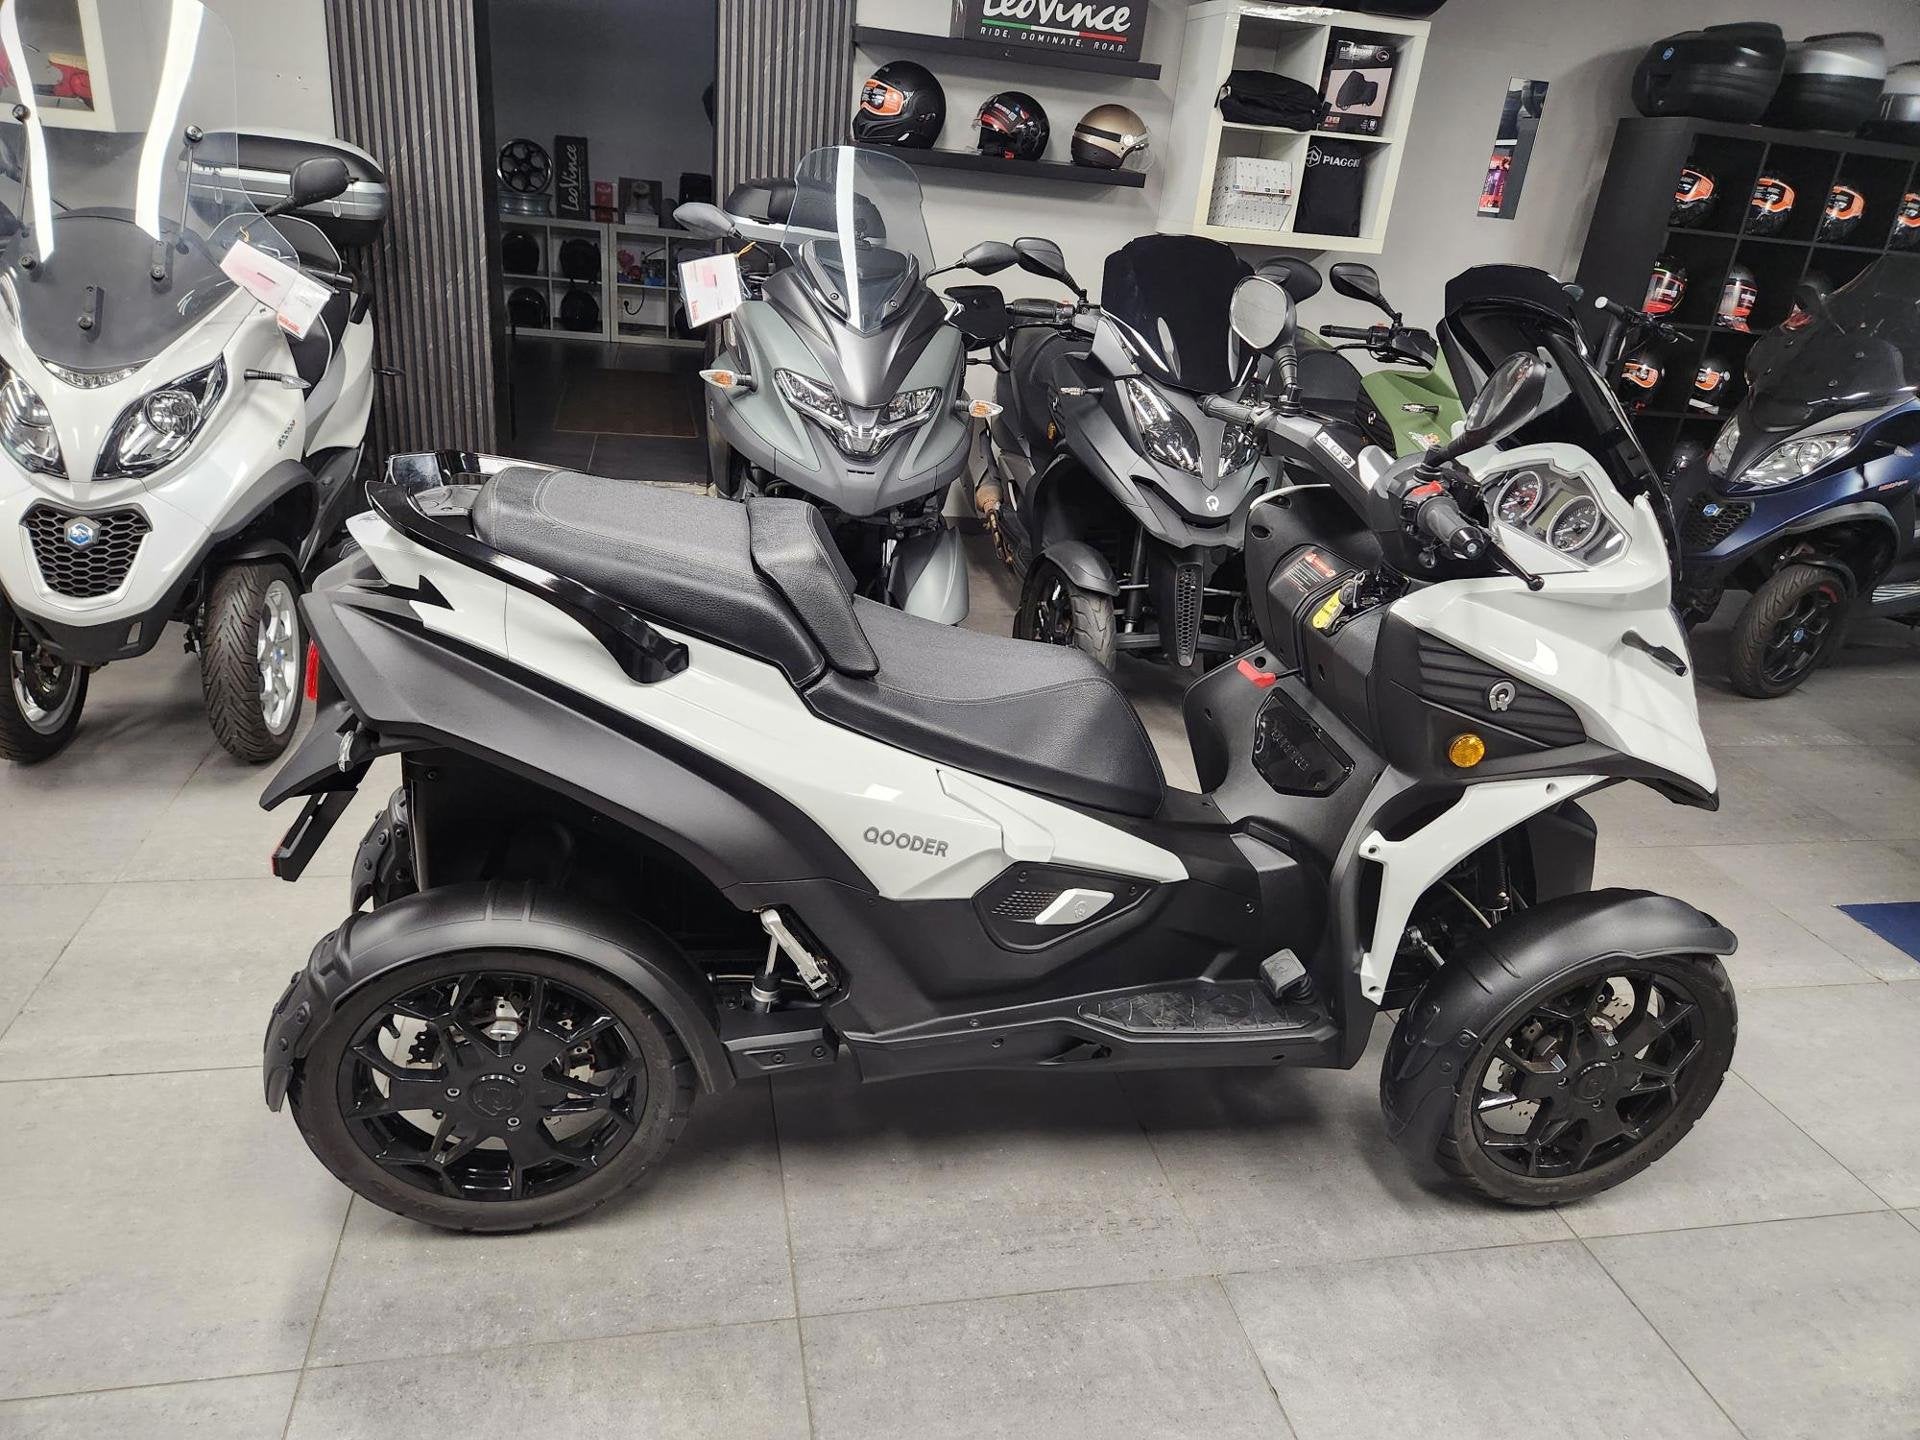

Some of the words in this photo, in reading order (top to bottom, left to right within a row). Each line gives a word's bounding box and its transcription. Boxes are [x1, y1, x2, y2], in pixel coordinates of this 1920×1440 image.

[980, 26, 1011, 39] RIDE.
[1020, 32, 1084, 48] DOMINATE.
[1093, 41, 1126, 53] ROAR.
[559, 144, 580, 211] LeoVince
[863, 826, 949, 858] QOODER
